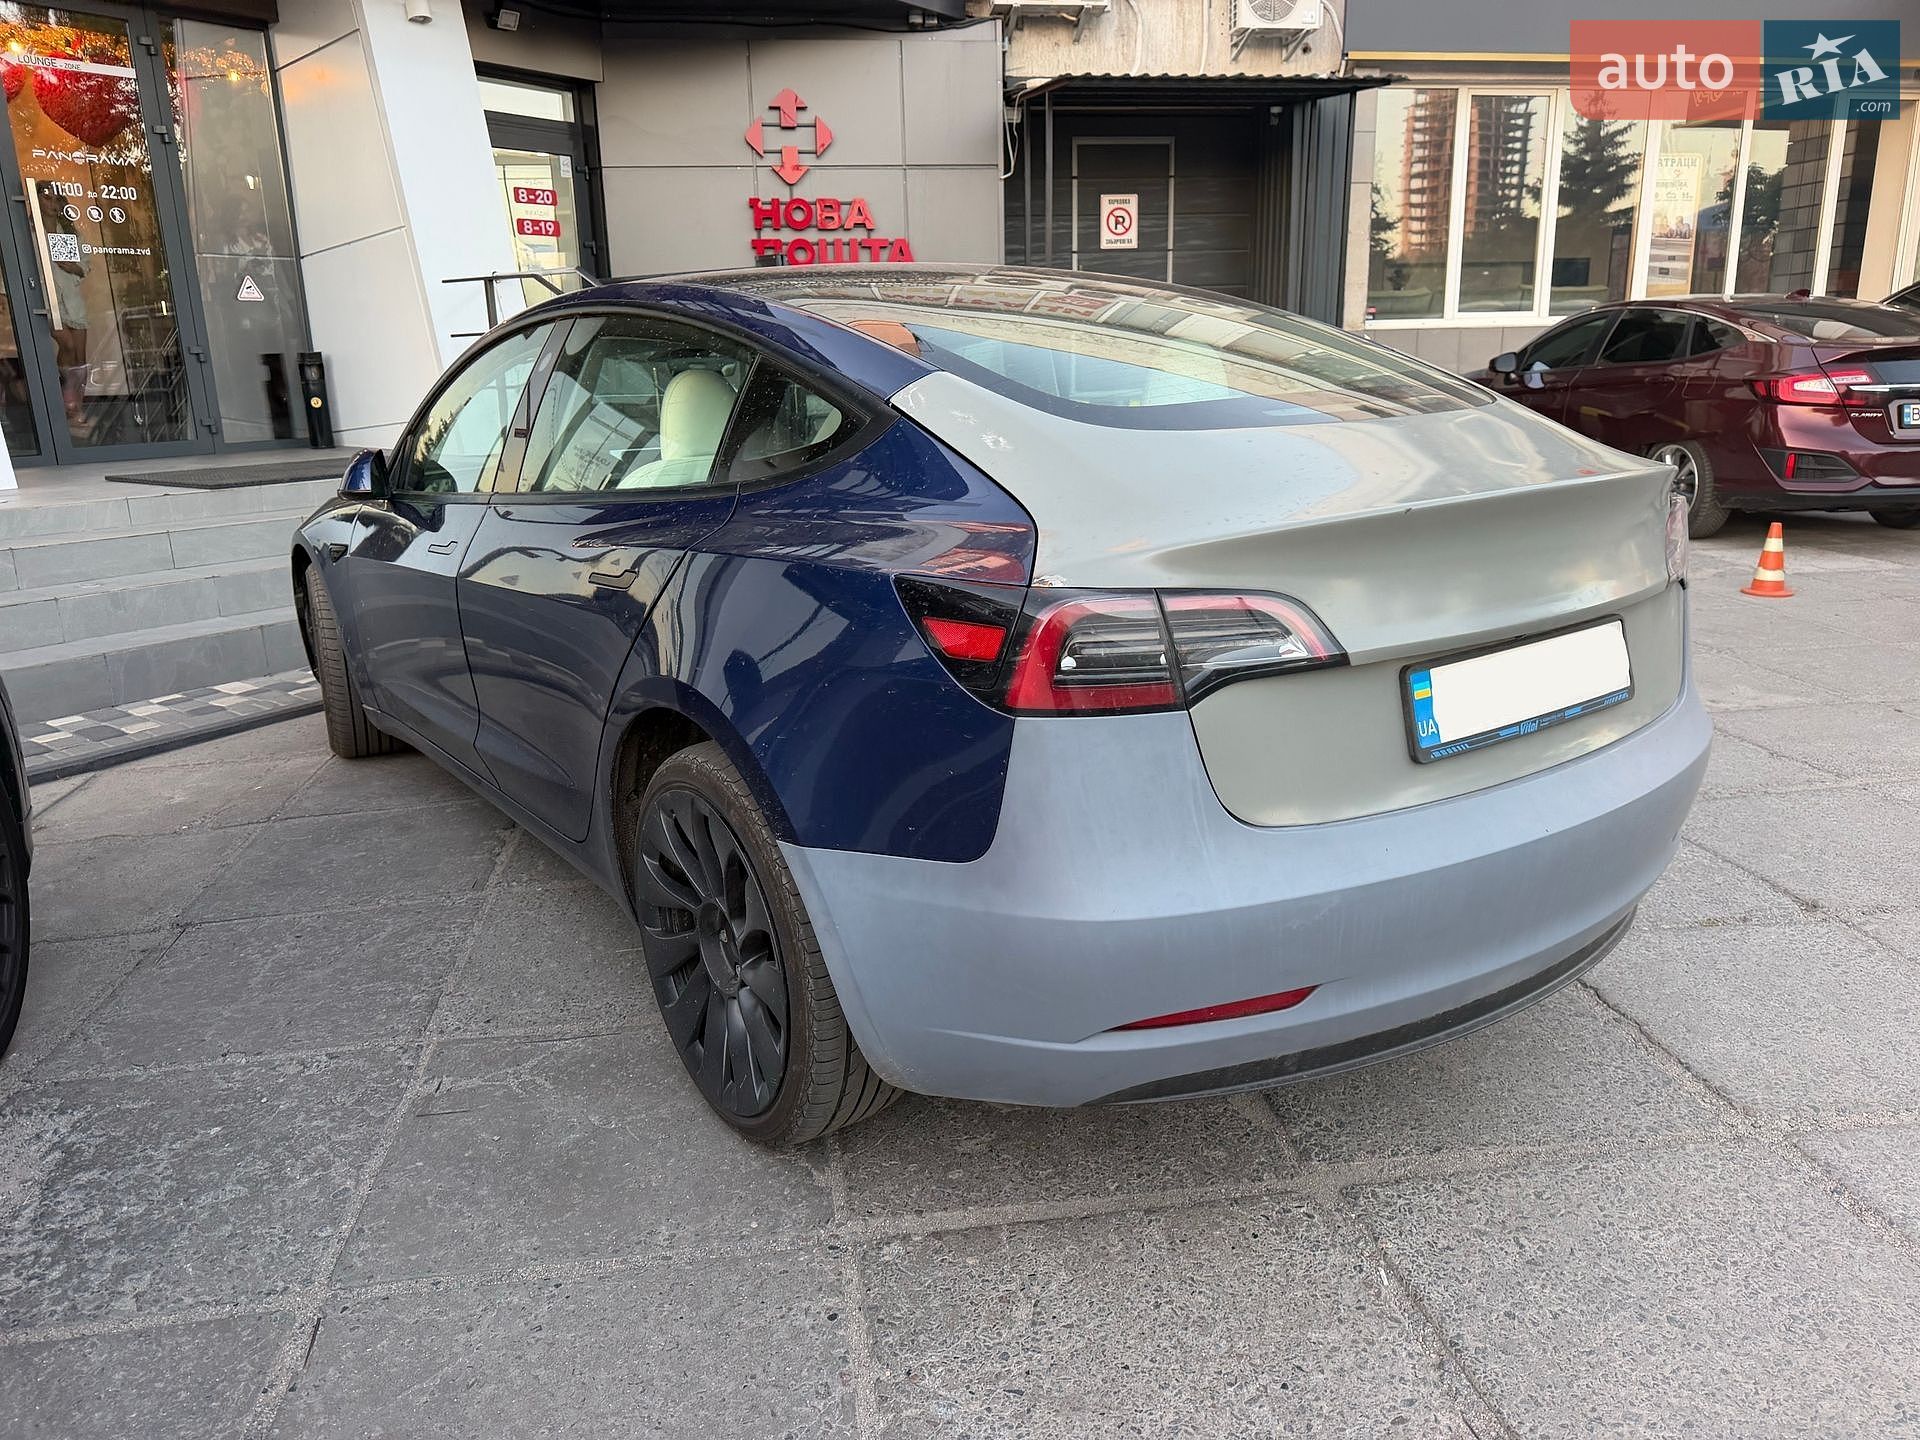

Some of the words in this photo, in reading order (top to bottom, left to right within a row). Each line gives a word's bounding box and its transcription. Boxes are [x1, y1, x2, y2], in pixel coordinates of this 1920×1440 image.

[17, 55, 57, 68] LOUNGE
[64, 62, 81, 70] ZONE
[32, 149, 136, 167] PANORAMA
[51, 181, 84, 197] 11:00
[100, 185, 138, 200] 22:00
[518, 189, 553, 204] 8-20
[749, 198, 877, 231] НОВА
[523, 220, 555, 235] 8-19
[93, 246, 151, 256] panorama.zvd
[1418, 718, 1438, 737] UA
